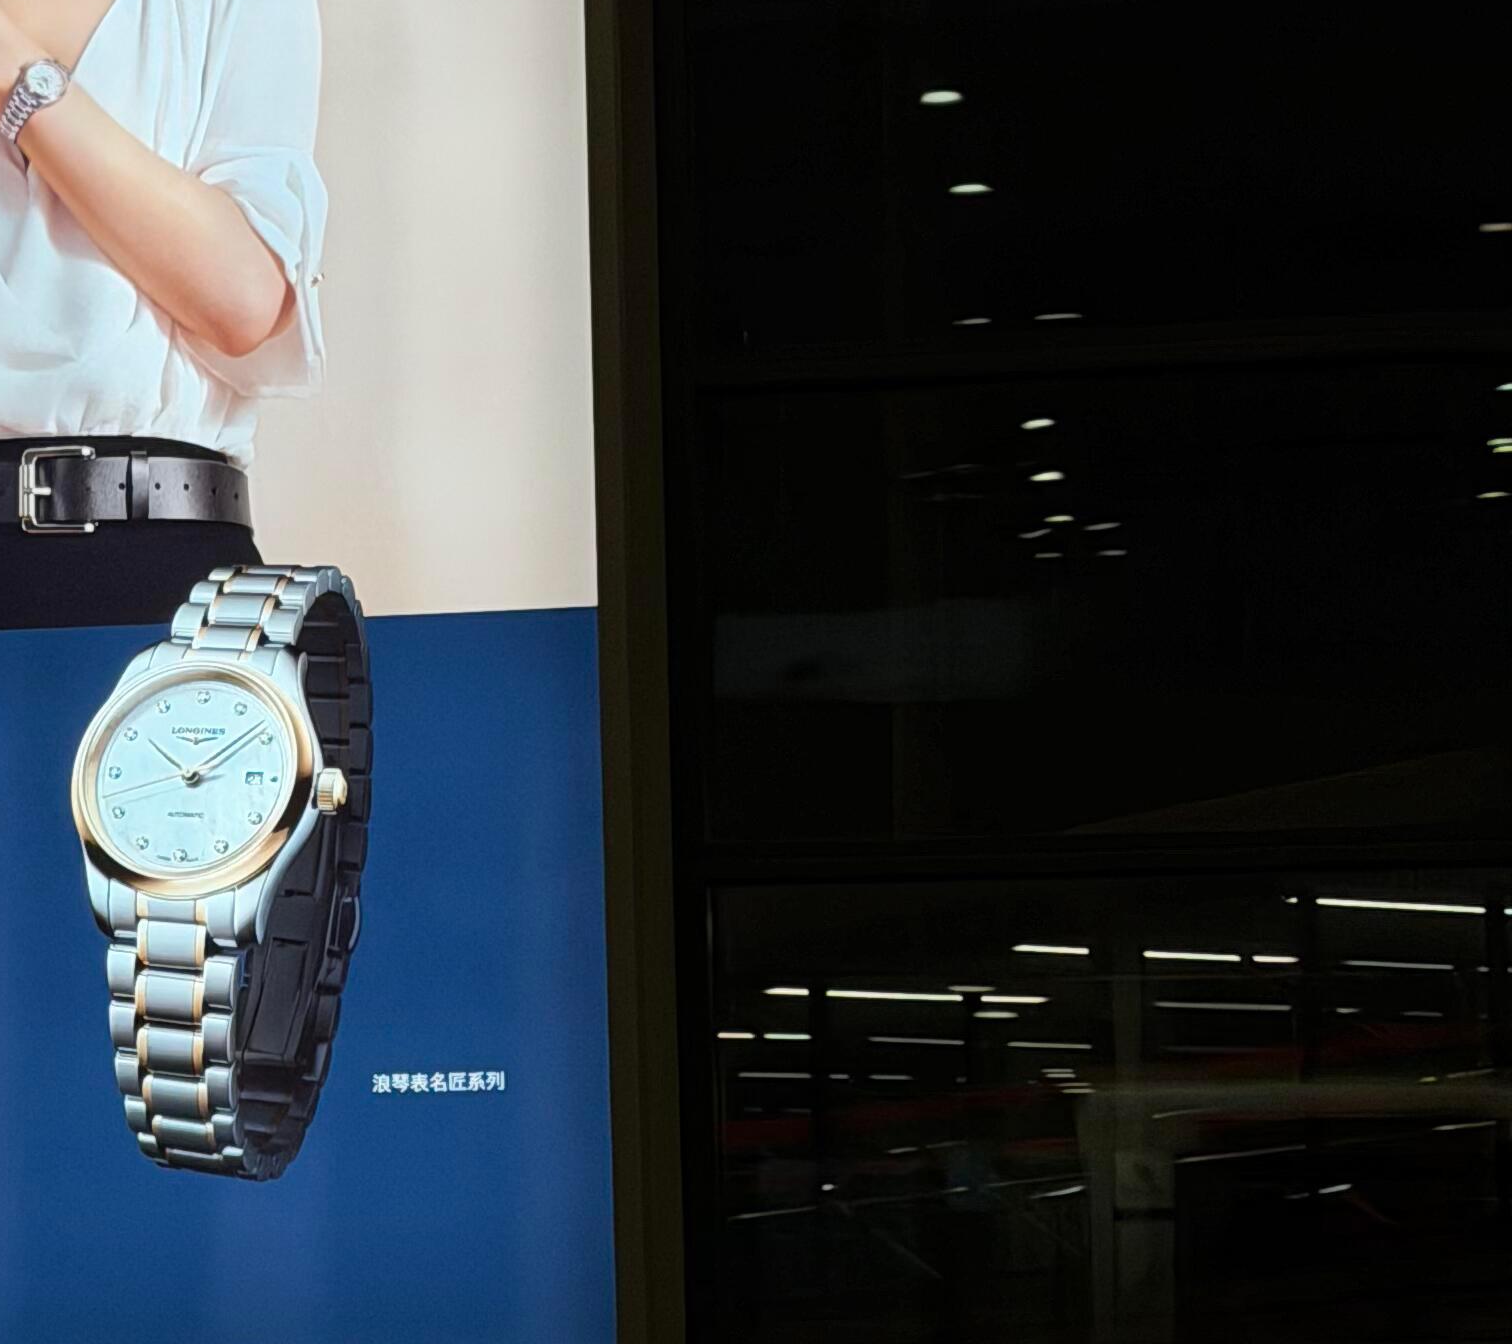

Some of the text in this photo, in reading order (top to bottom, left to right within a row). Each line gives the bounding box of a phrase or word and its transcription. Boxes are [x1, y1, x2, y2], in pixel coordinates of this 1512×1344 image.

[171, 726, 226, 736] LONGINES
[371, 1070, 506, 1094] 浪琴表名匠系列
